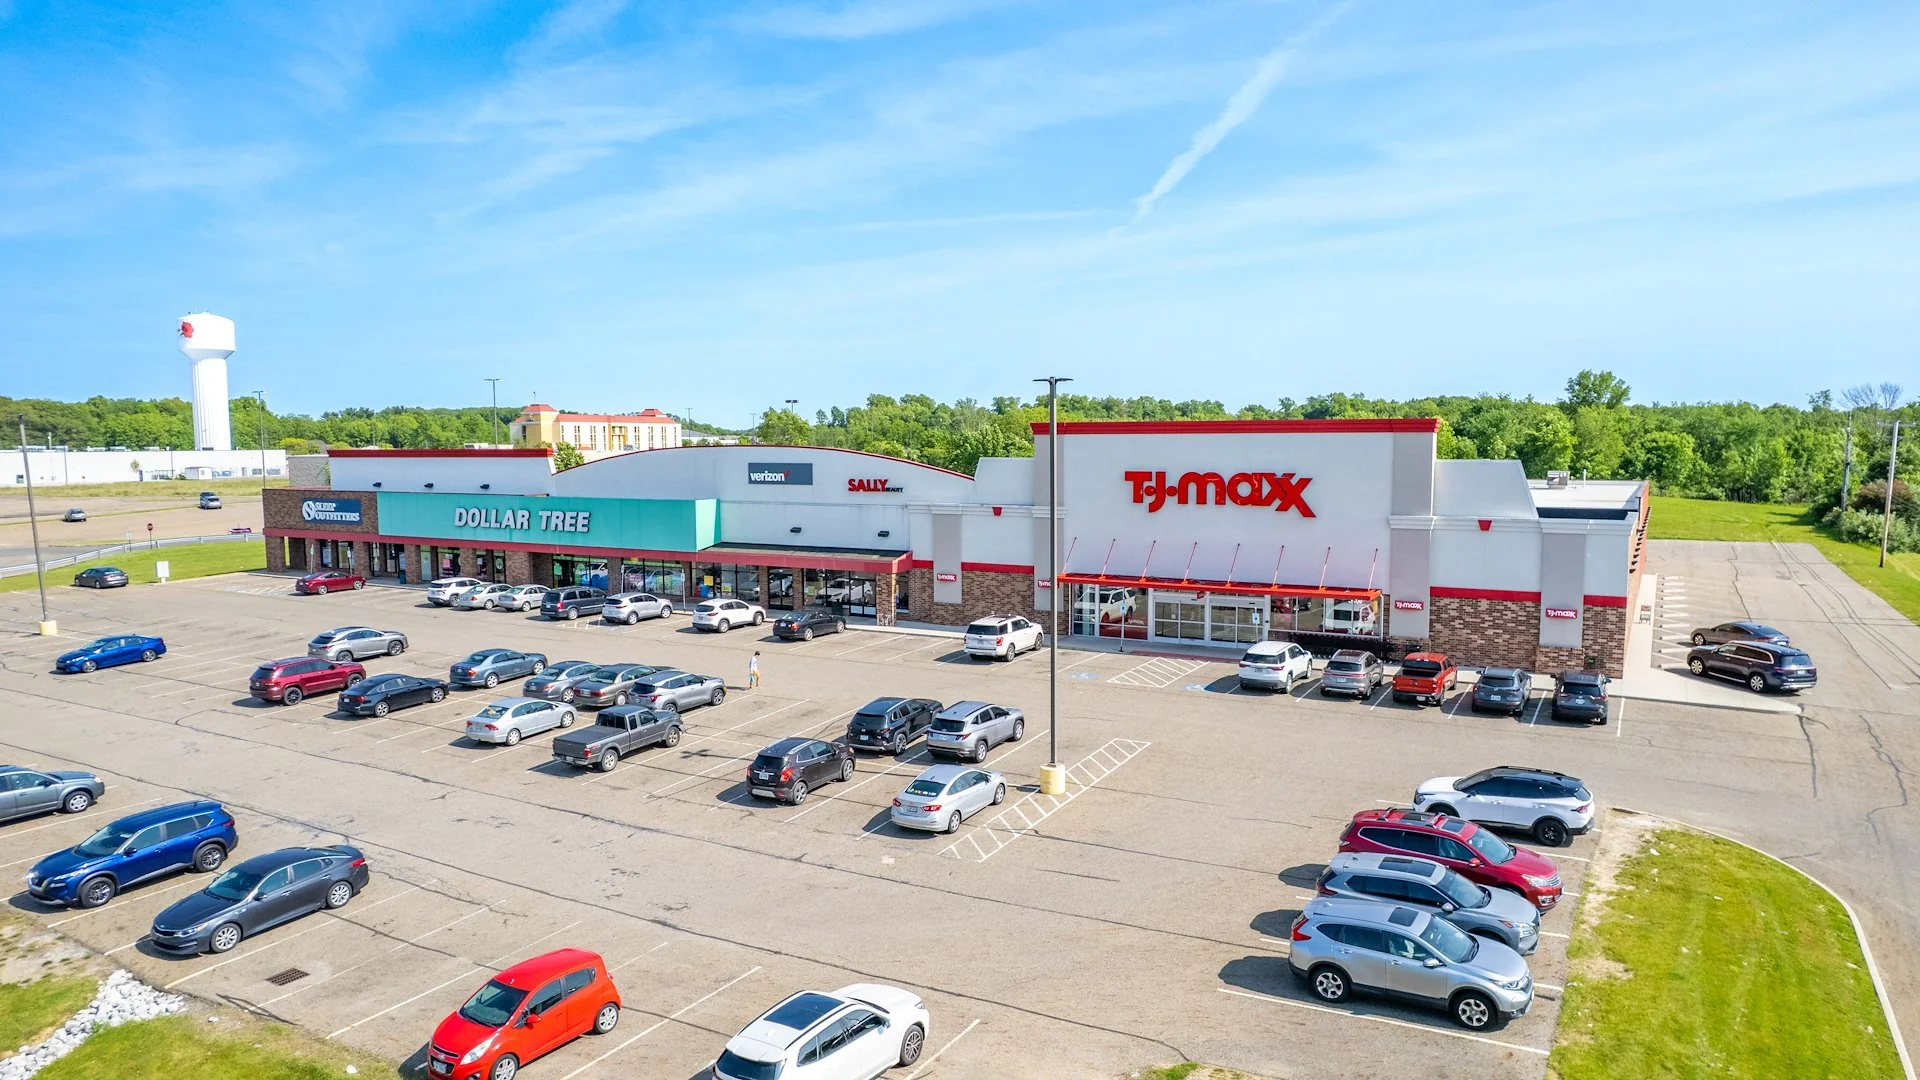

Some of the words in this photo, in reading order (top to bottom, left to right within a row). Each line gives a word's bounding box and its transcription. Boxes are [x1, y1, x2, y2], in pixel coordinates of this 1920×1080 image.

[750, 471, 785, 482] verizon
[848, 479, 888, 492] SALLY
[315, 502, 336, 511] SLEEP
[315, 511, 360, 522] OUTFITTERS
[454, 507, 530, 530] DOLLAR
[538, 510, 591, 533] TREE
